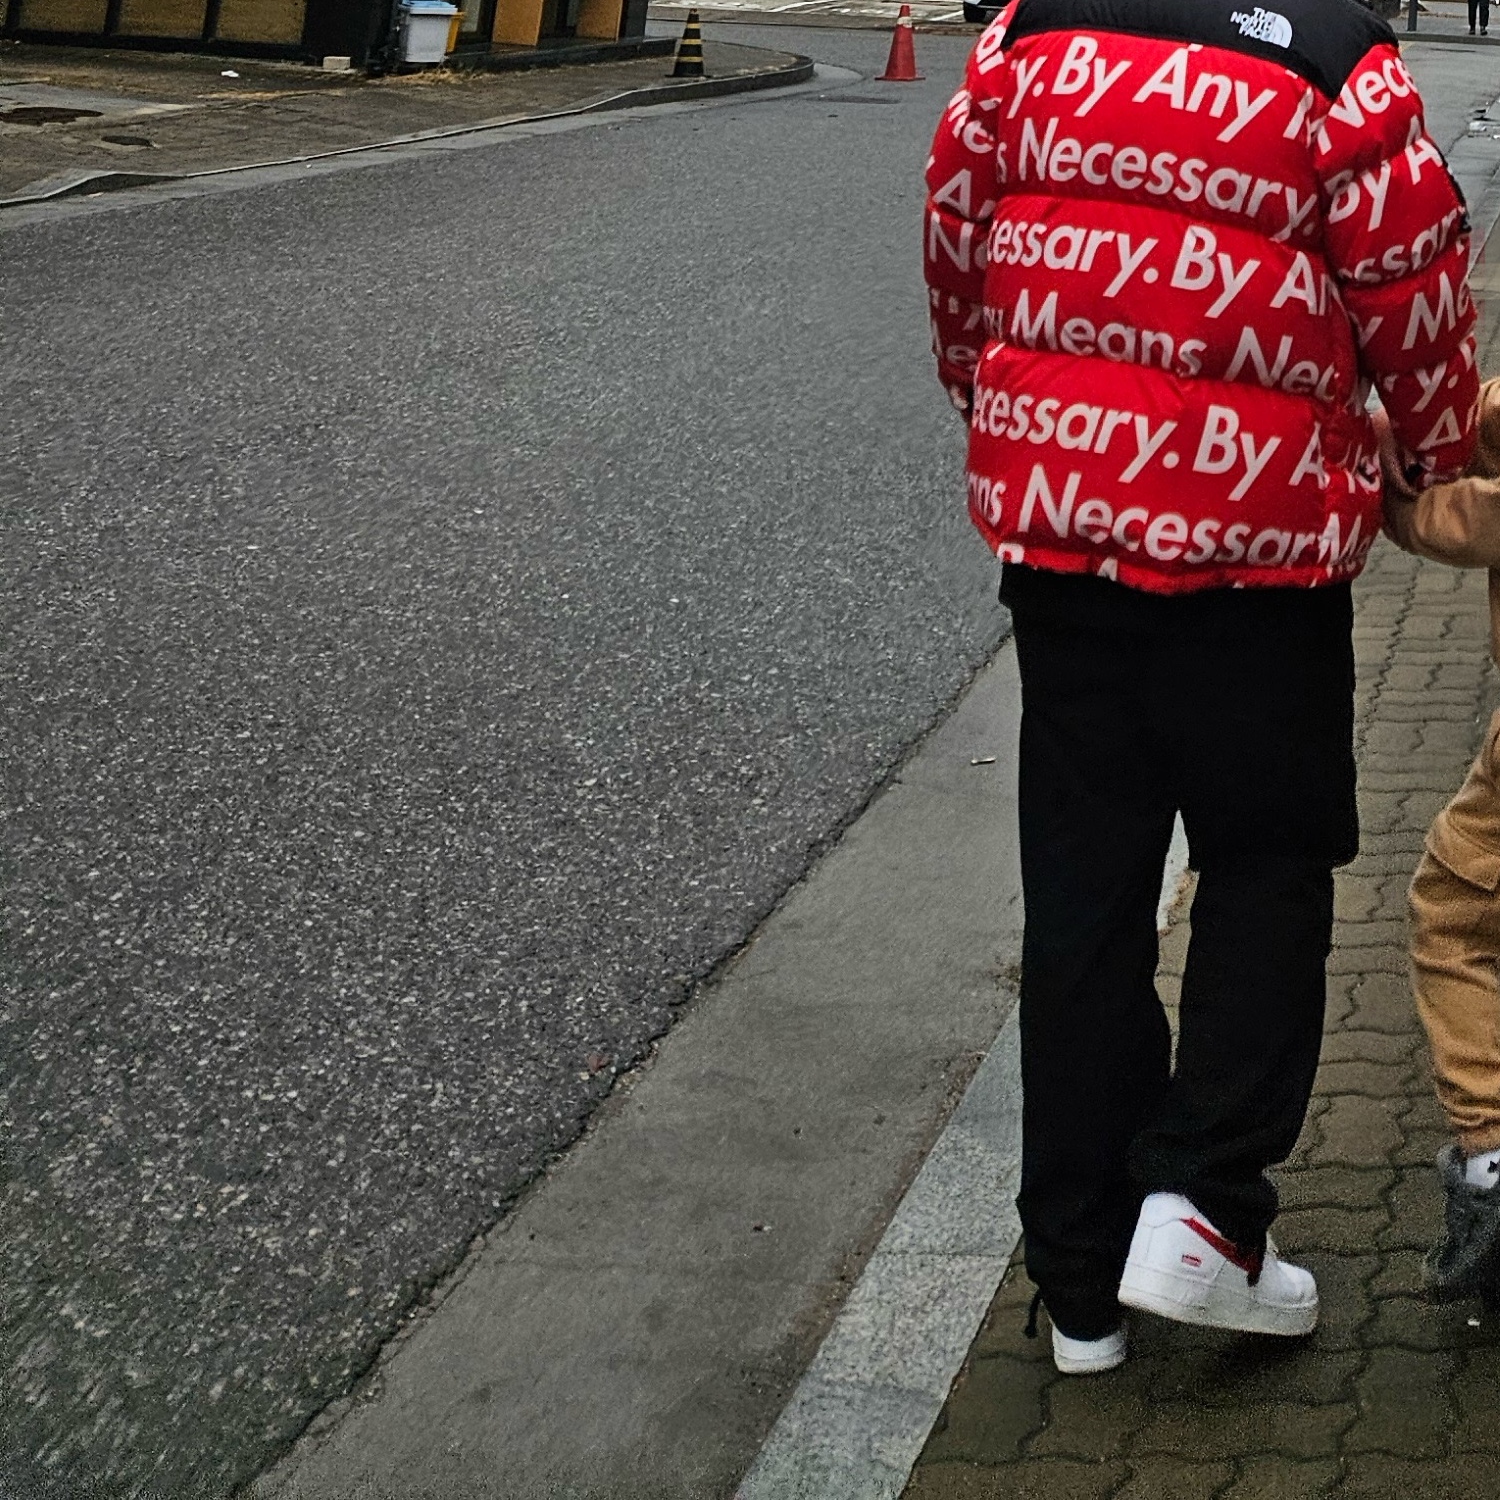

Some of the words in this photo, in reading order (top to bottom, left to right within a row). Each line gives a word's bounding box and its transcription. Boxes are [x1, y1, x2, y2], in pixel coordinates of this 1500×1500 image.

[1051, 35, 1133, 118] By
[1131, 46, 1278, 143] Any
[1018, 116, 1319, 245] Necessary.
[1169, 222, 1261, 318] By
[1010, 287, 1208, 377] Means
[1192, 404, 1283, 502] By
